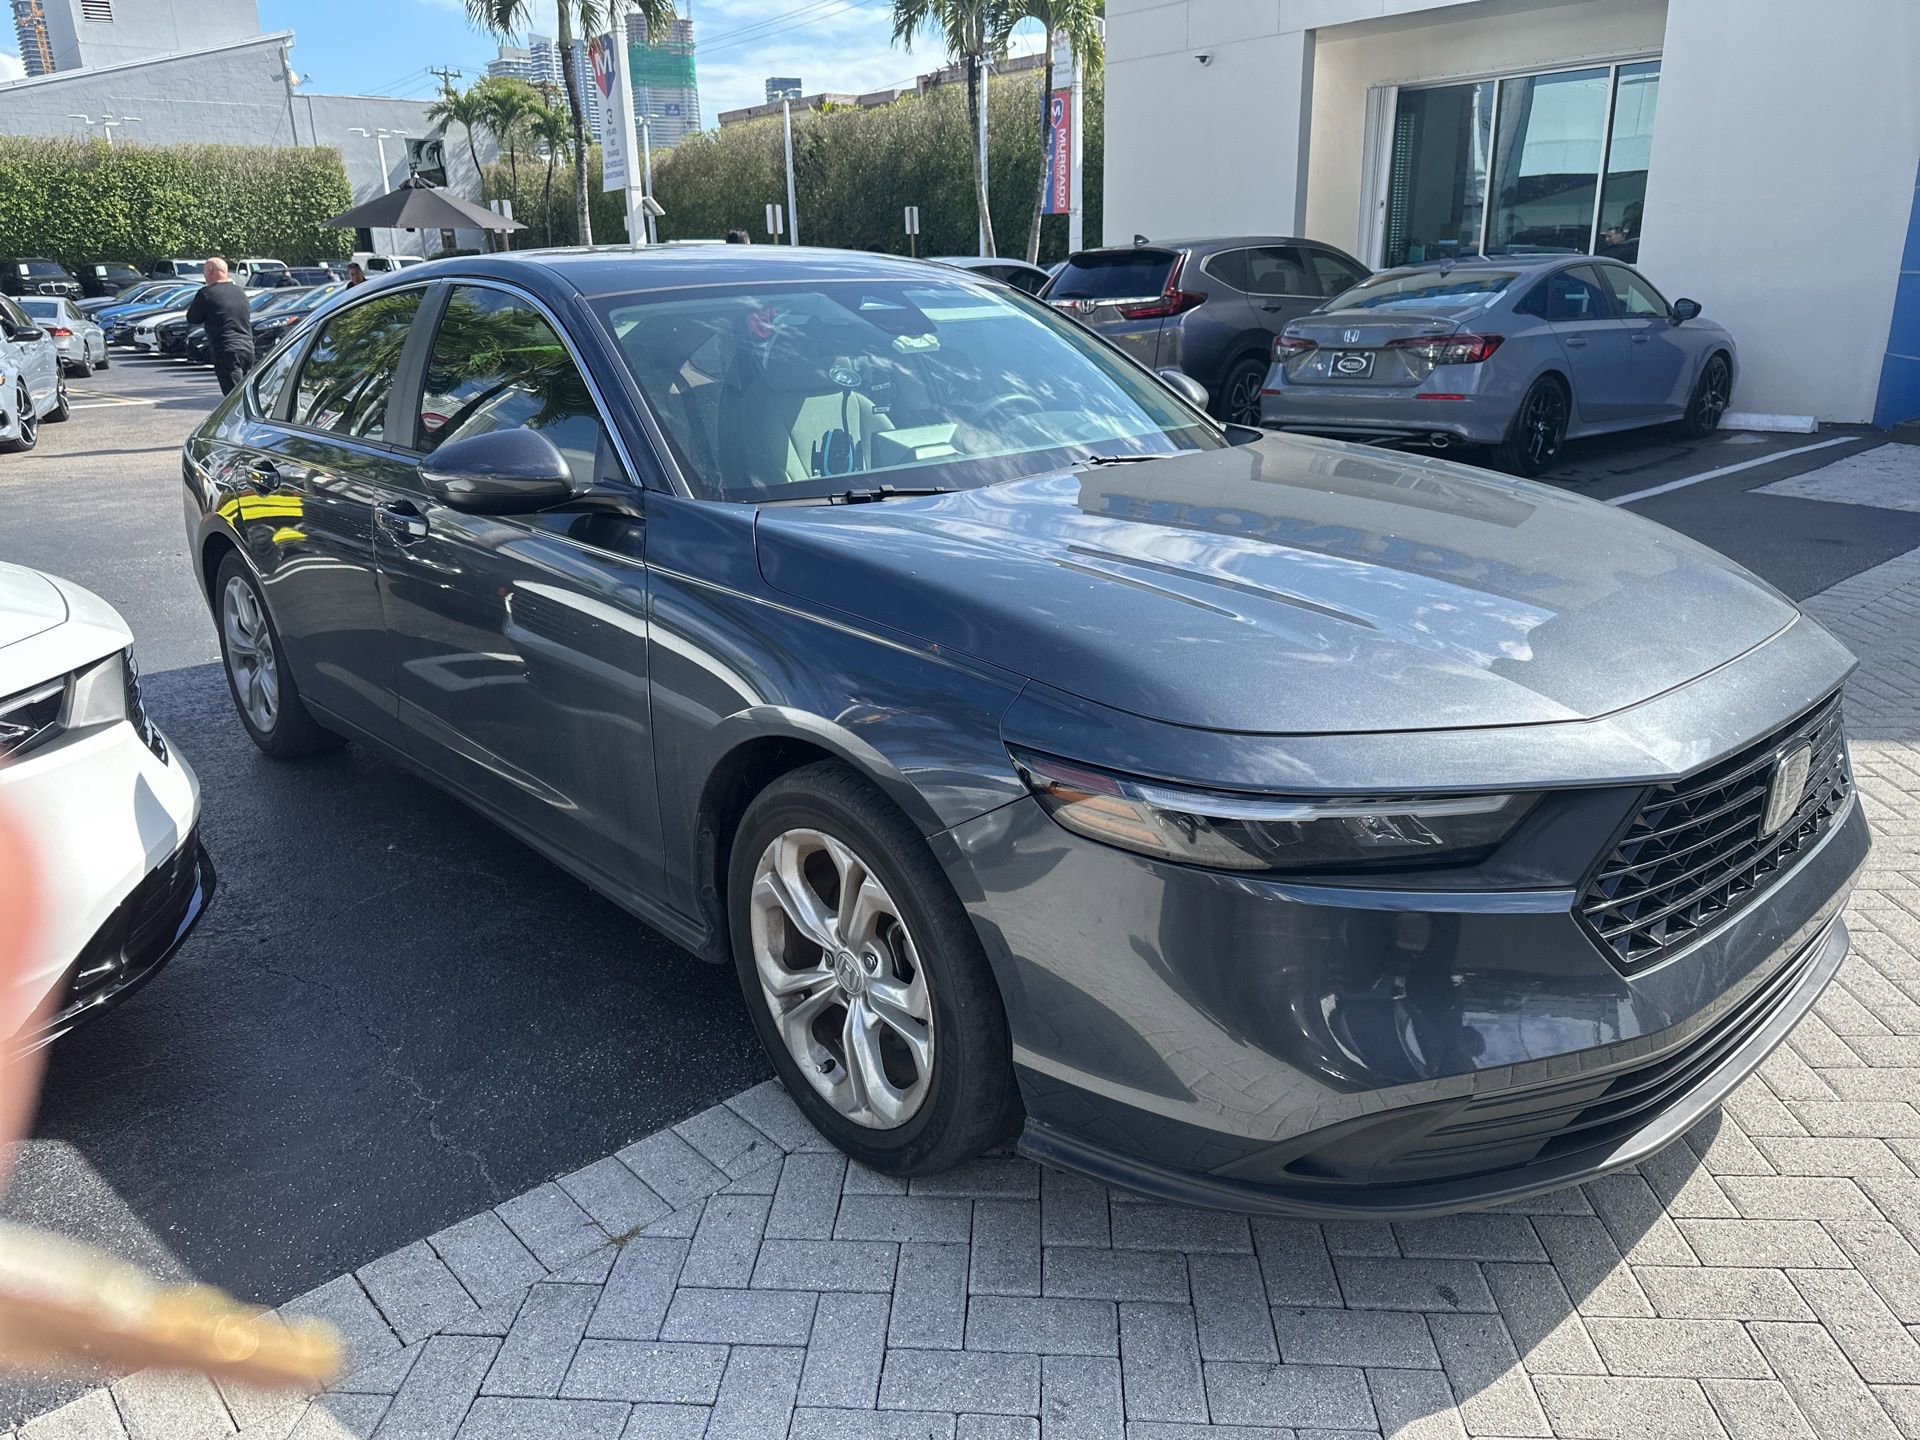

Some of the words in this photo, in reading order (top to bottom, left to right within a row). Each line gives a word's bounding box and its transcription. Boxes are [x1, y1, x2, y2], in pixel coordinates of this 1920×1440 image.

[594, 48, 613, 76] M
[606, 108, 614, 125] 3
[1059, 128, 1067, 208] MURGADO
